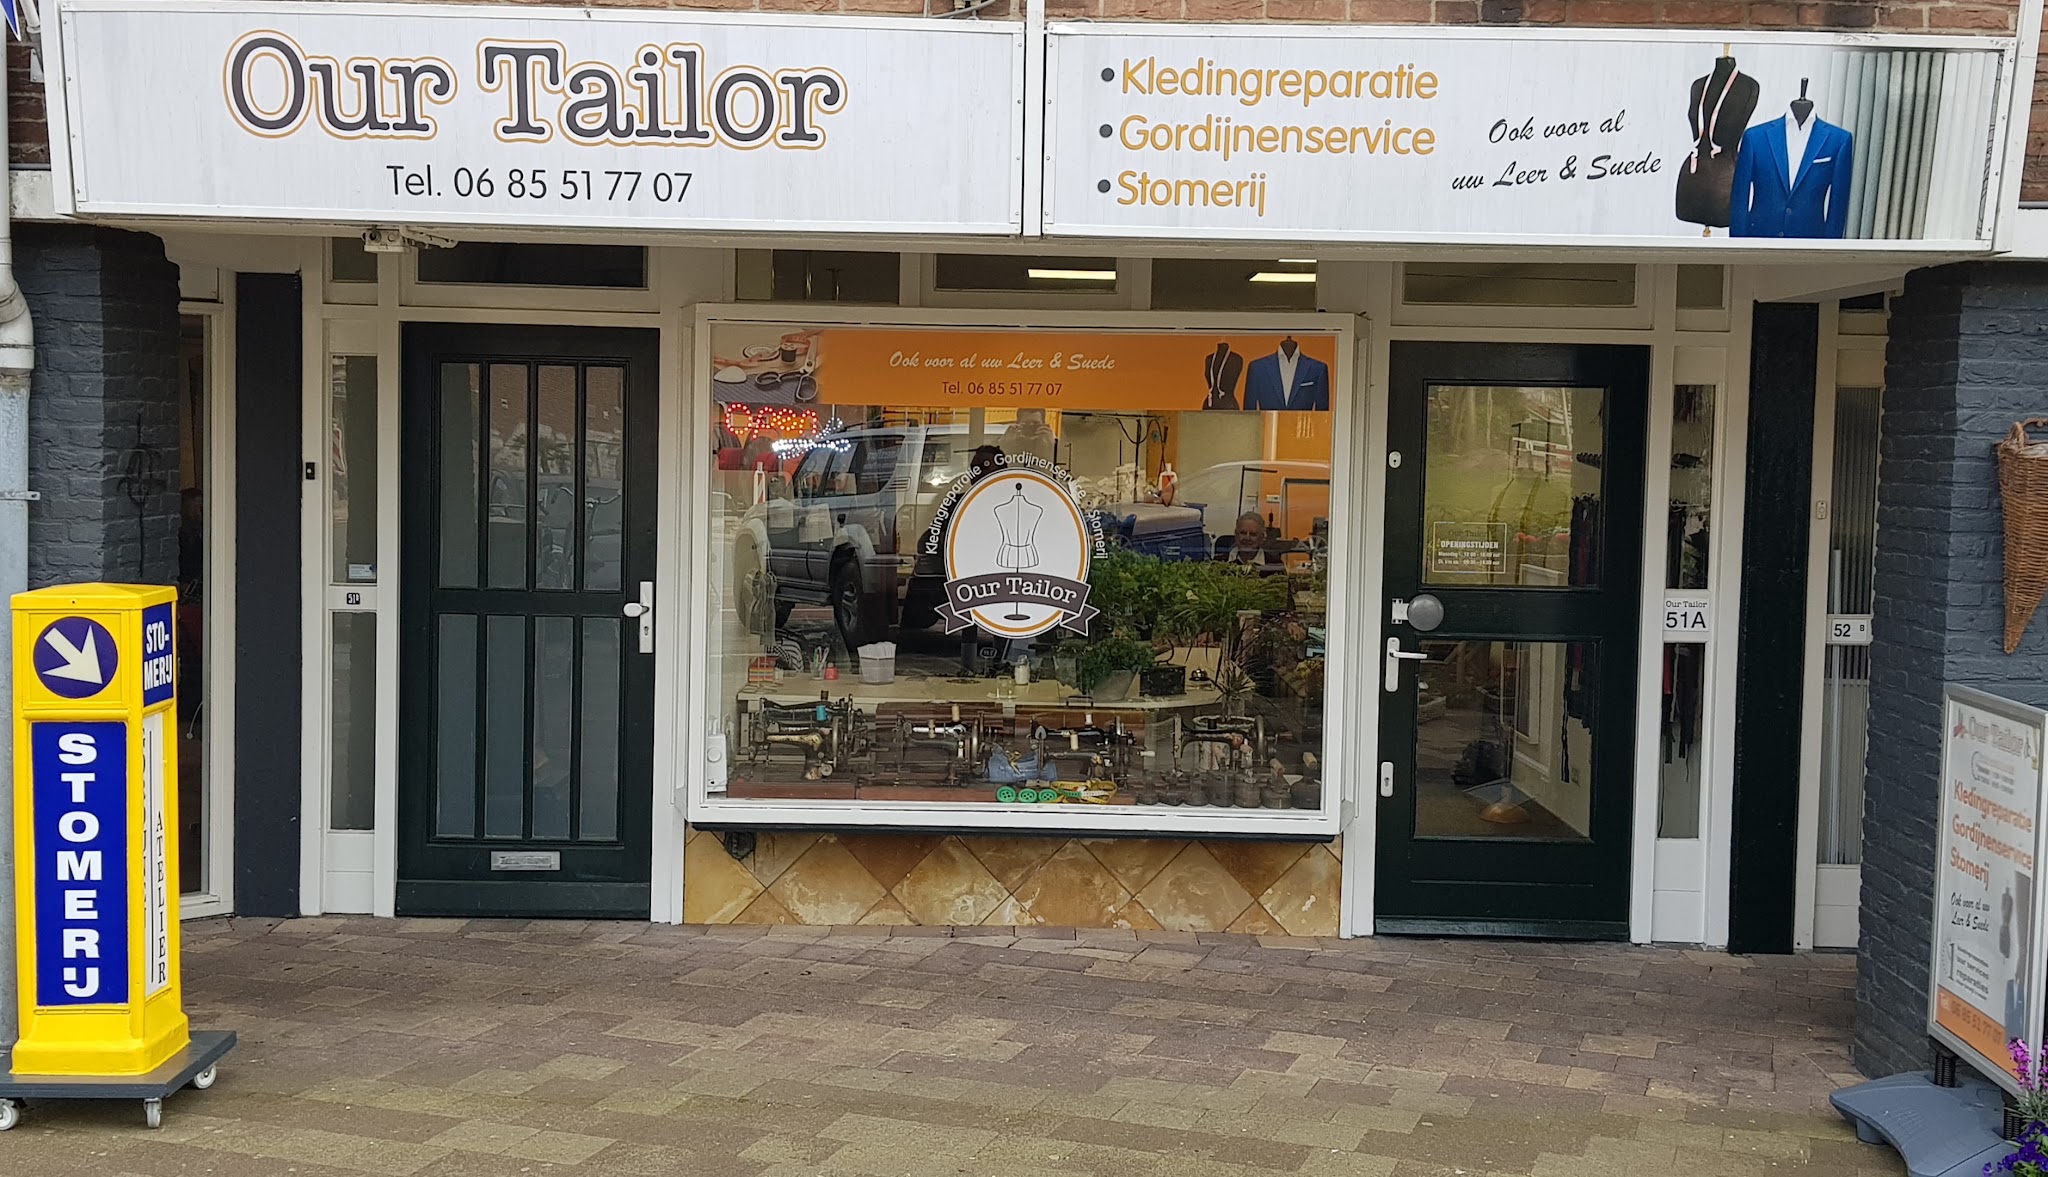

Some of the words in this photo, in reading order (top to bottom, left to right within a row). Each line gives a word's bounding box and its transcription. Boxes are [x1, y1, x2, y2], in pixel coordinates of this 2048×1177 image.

[224, 30, 457, 138] Our
[478, 39, 847, 149] Tailor
[1122, 57, 1439, 107] Kledingreparatie
[1120, 114, 1437, 161] Gordijnenservice
[1488, 116, 1534, 144] Ook
[1543, 121, 1590, 139] voor
[1599, 109, 1626, 133] al
[386, 164, 442, 197] Tel.
[453, 167, 495, 198] 06
[507, 168, 547, 199] 85
[560, 170, 591, 201] 51
[604, 170, 642, 202] 77
[653, 172, 693, 203] 07
[1451, 175, 1484, 190] uw
[1492, 160, 1548, 187] Leer
[1559, 155, 1577, 180] &
[1586, 151, 1661, 180] Suede
[1117, 170, 1267, 217] Stomerij
[889, 351, 920, 368] Ook
[924, 355, 955, 368] voor
[959, 353, 977, 369] al
[981, 358, 1003, 369] uw
[1007, 352, 1044, 369] Leer
[1049, 352, 1062, 369] &
[1066, 353, 1115, 370] Suede
[942, 381, 964, 394] Tel.
[967, 382, 985, 395] 06
[988, 382, 1005, 395] 85
[1009, 382, 1023, 396] 51
[1027, 383, 1043, 396] 77
[1045, 383, 1063, 396] 07
[925, 465, 982, 555] Kledingreparatie
[993, 451, 1087, 500] Gordijnenservice
[1088, 508, 1109, 560] Stomerij
[1440, 540, 1499, 549] OPENINGSTIJDEN
[955, 580, 1001, 603] Our
[1005, 576, 1078, 604] Tailor
[1665, 600, 1682, 608] Our
[1683, 600, 1708, 608] Tailor
[146, 620, 170, 654] STO-
[1665, 611, 1706, 629] 51A
[1834, 623, 1851, 637] 52
[1950, 846, 1990, 892] Stomerij
[156, 810, 167, 984] ATELIER
